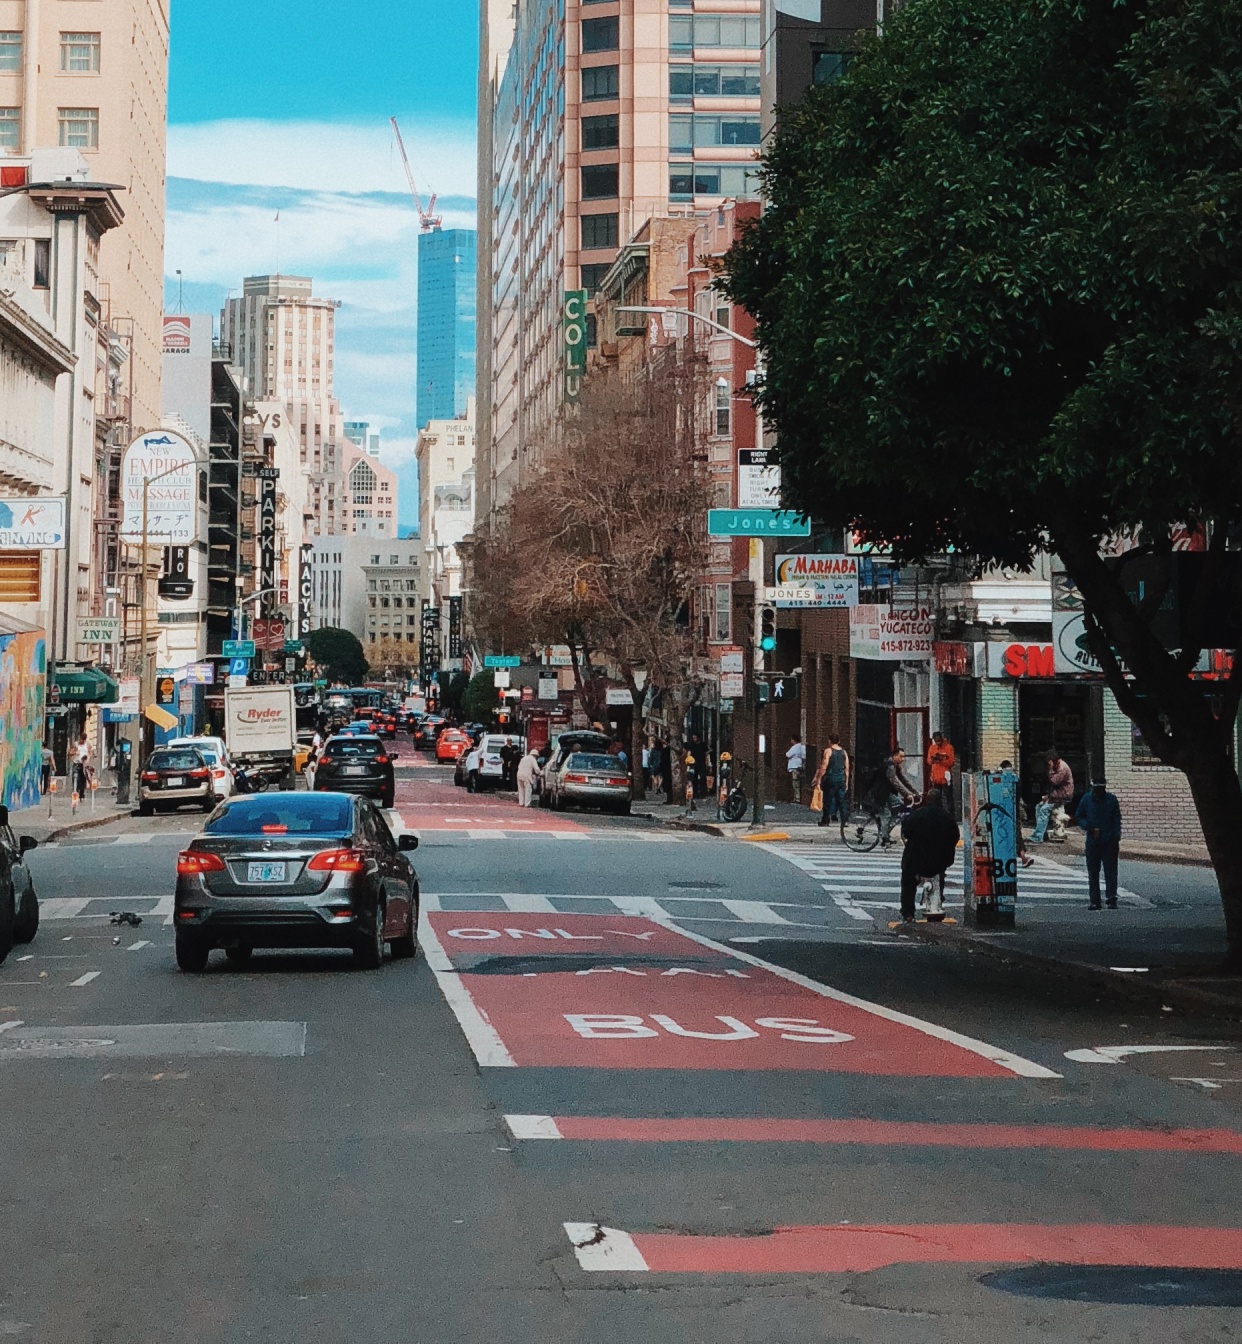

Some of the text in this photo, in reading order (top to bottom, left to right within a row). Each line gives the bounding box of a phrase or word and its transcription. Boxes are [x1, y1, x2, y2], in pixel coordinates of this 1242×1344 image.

[446, 424, 473, 432] PHELAN
[149, 447, 171, 456] NEW
[130, 458, 190, 476] EMPIRE
[260, 469, 279, 477] SELF
[128, 476, 192, 485] HEATH CLUB
[728, 515, 791, 530] Jones
[794, 556, 857, 574] MARHABA
[769, 590, 811, 599] JONES
[78, 619, 119, 627] GATEWAY
[880, 621, 932, 635] YUCATECO
[82, 629, 113, 640] INN
[881, 639, 935, 652] 415-872-9231
[253, 671, 284, 681] ENTER
[247, 707, 283, 719] Ryder
[447, 928, 656, 941] ONLY
[563, 1013, 856, 1044] BUS
